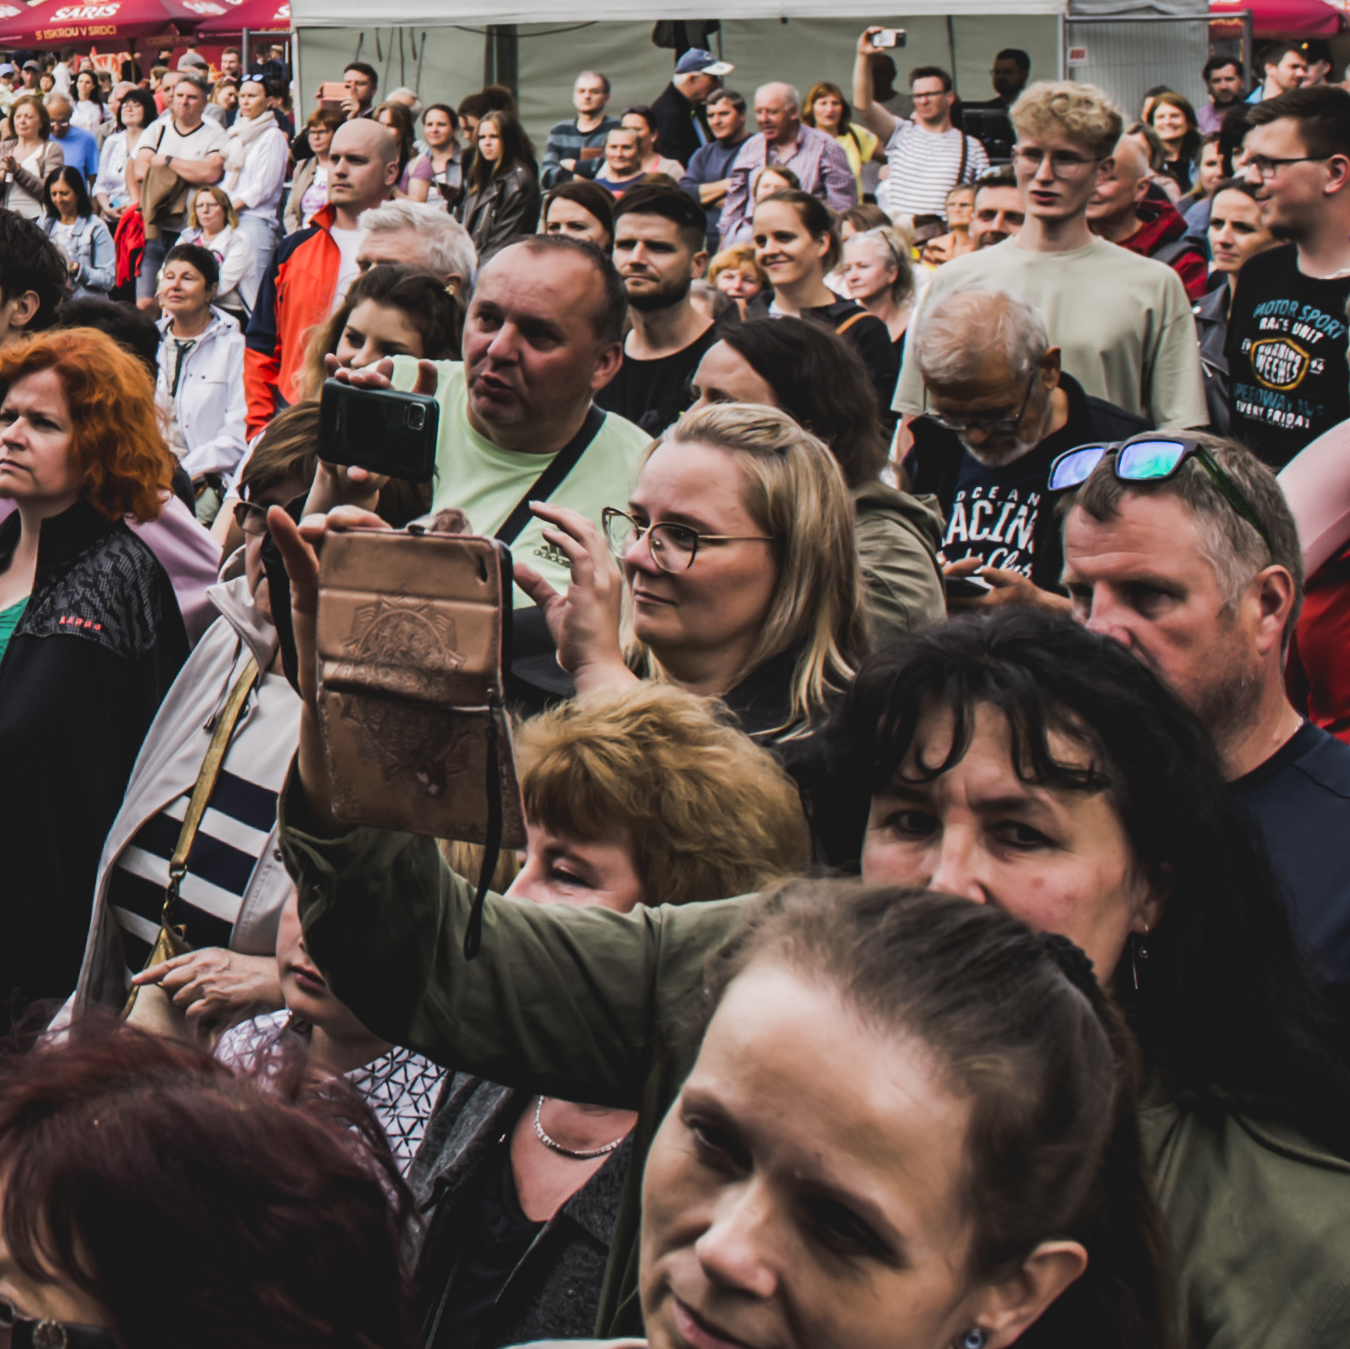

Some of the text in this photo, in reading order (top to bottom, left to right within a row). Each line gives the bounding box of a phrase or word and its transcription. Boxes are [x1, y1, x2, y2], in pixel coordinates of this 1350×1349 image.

[1253, 299, 1347, 339] MOTOR SPORT
[1291, 322, 1324, 344] UNIT
